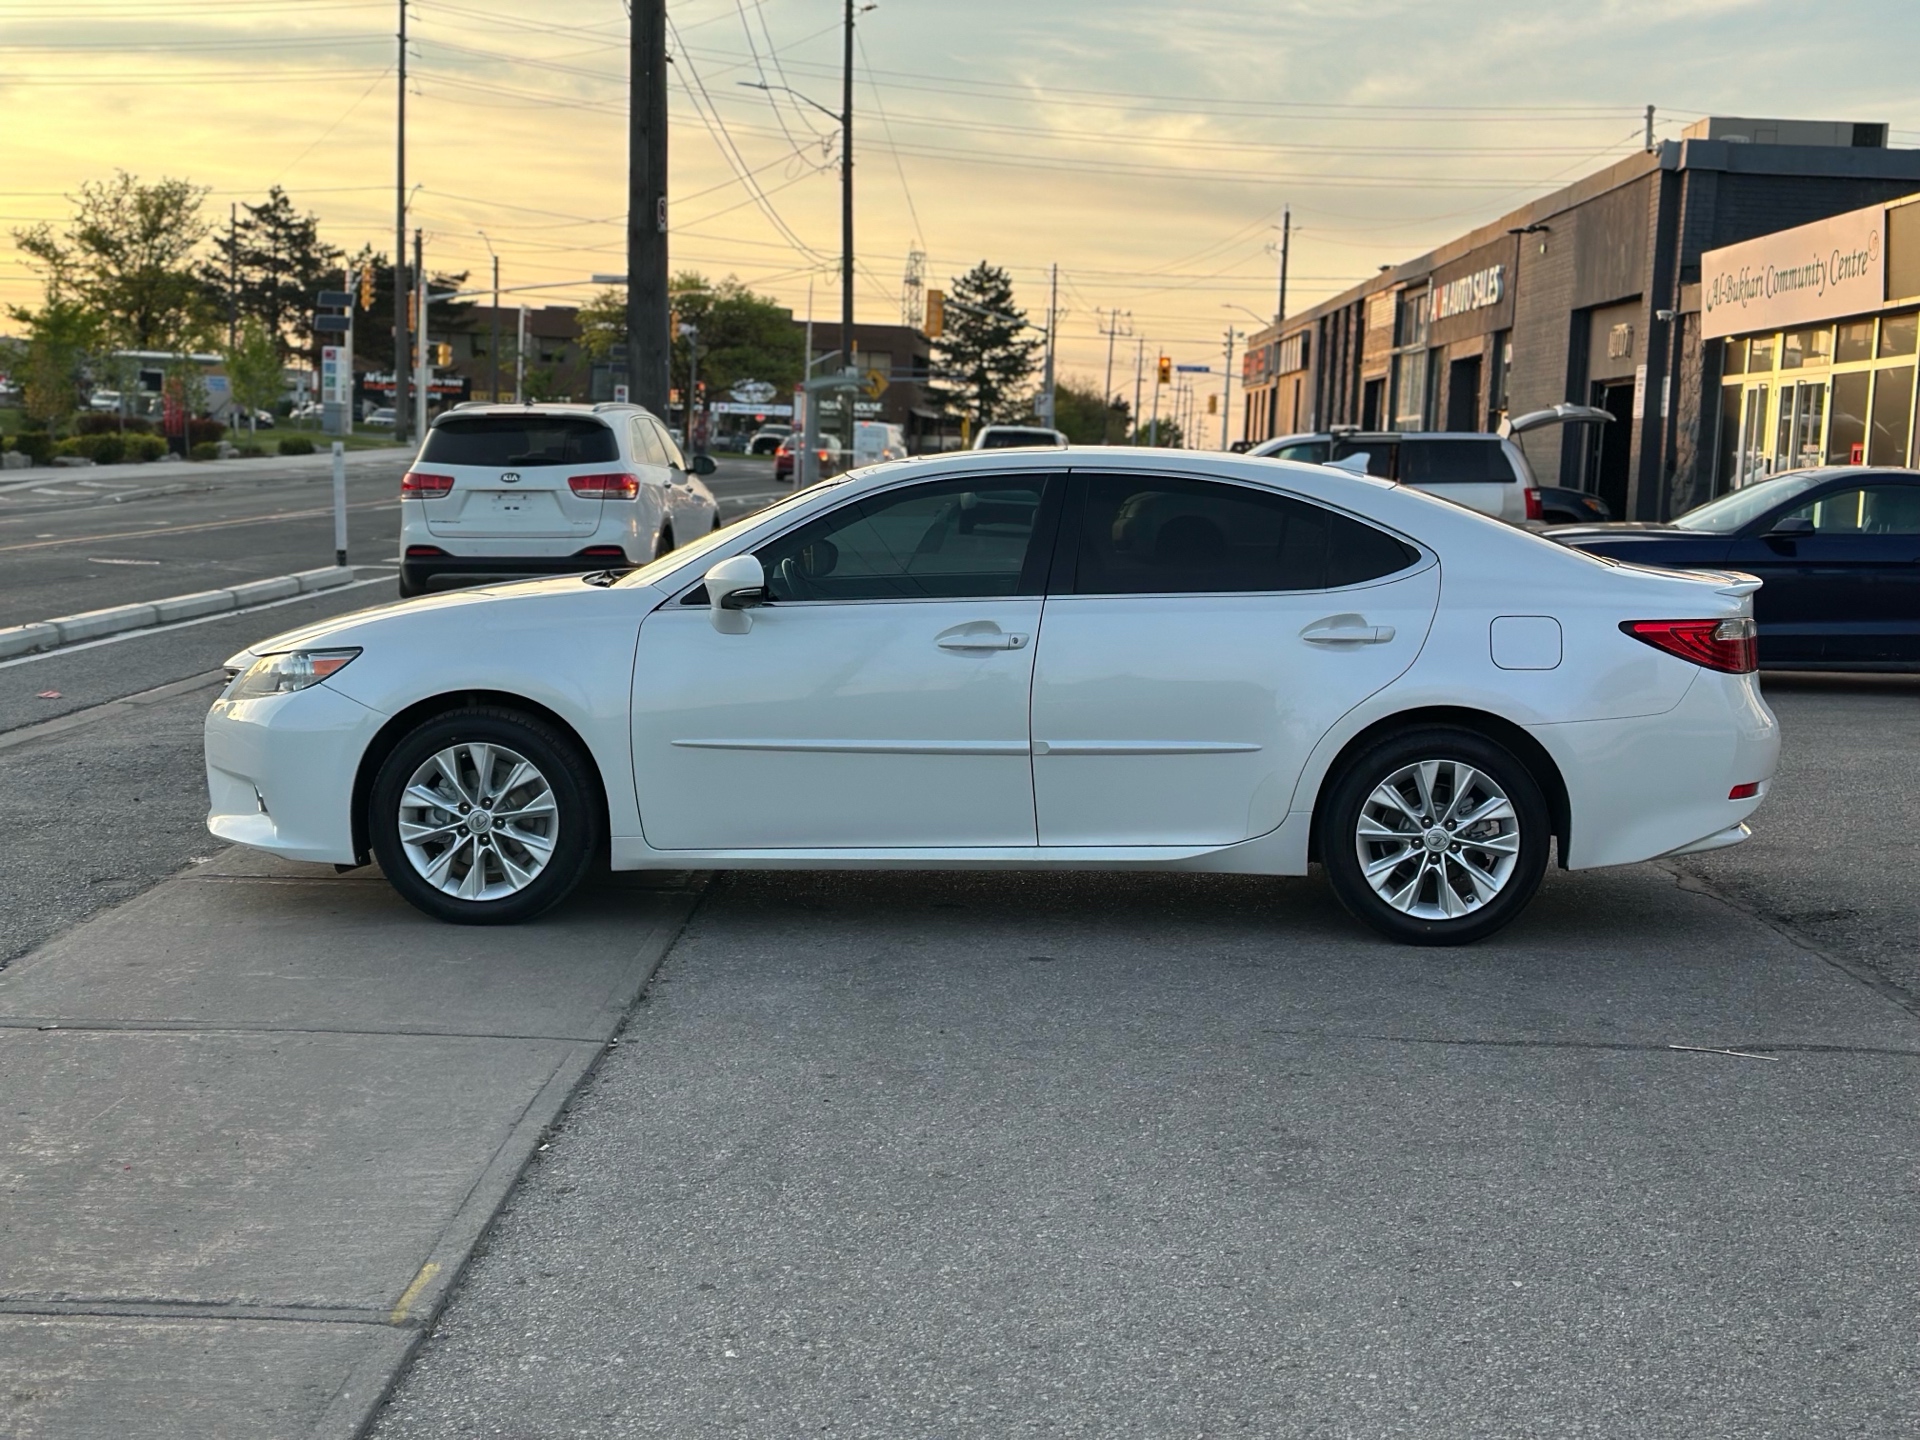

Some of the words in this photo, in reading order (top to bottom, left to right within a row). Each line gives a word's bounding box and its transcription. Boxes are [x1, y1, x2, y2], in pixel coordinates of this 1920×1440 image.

[1449, 274, 1473, 316] AUTO
[1472, 264, 1501, 310] SALES
[1706, 266, 1764, 312] Al-Bukhari
[1766, 253, 1827, 297] Community
[1829, 249, 1869, 286] Centre
[502, 473, 519, 482] KIA
